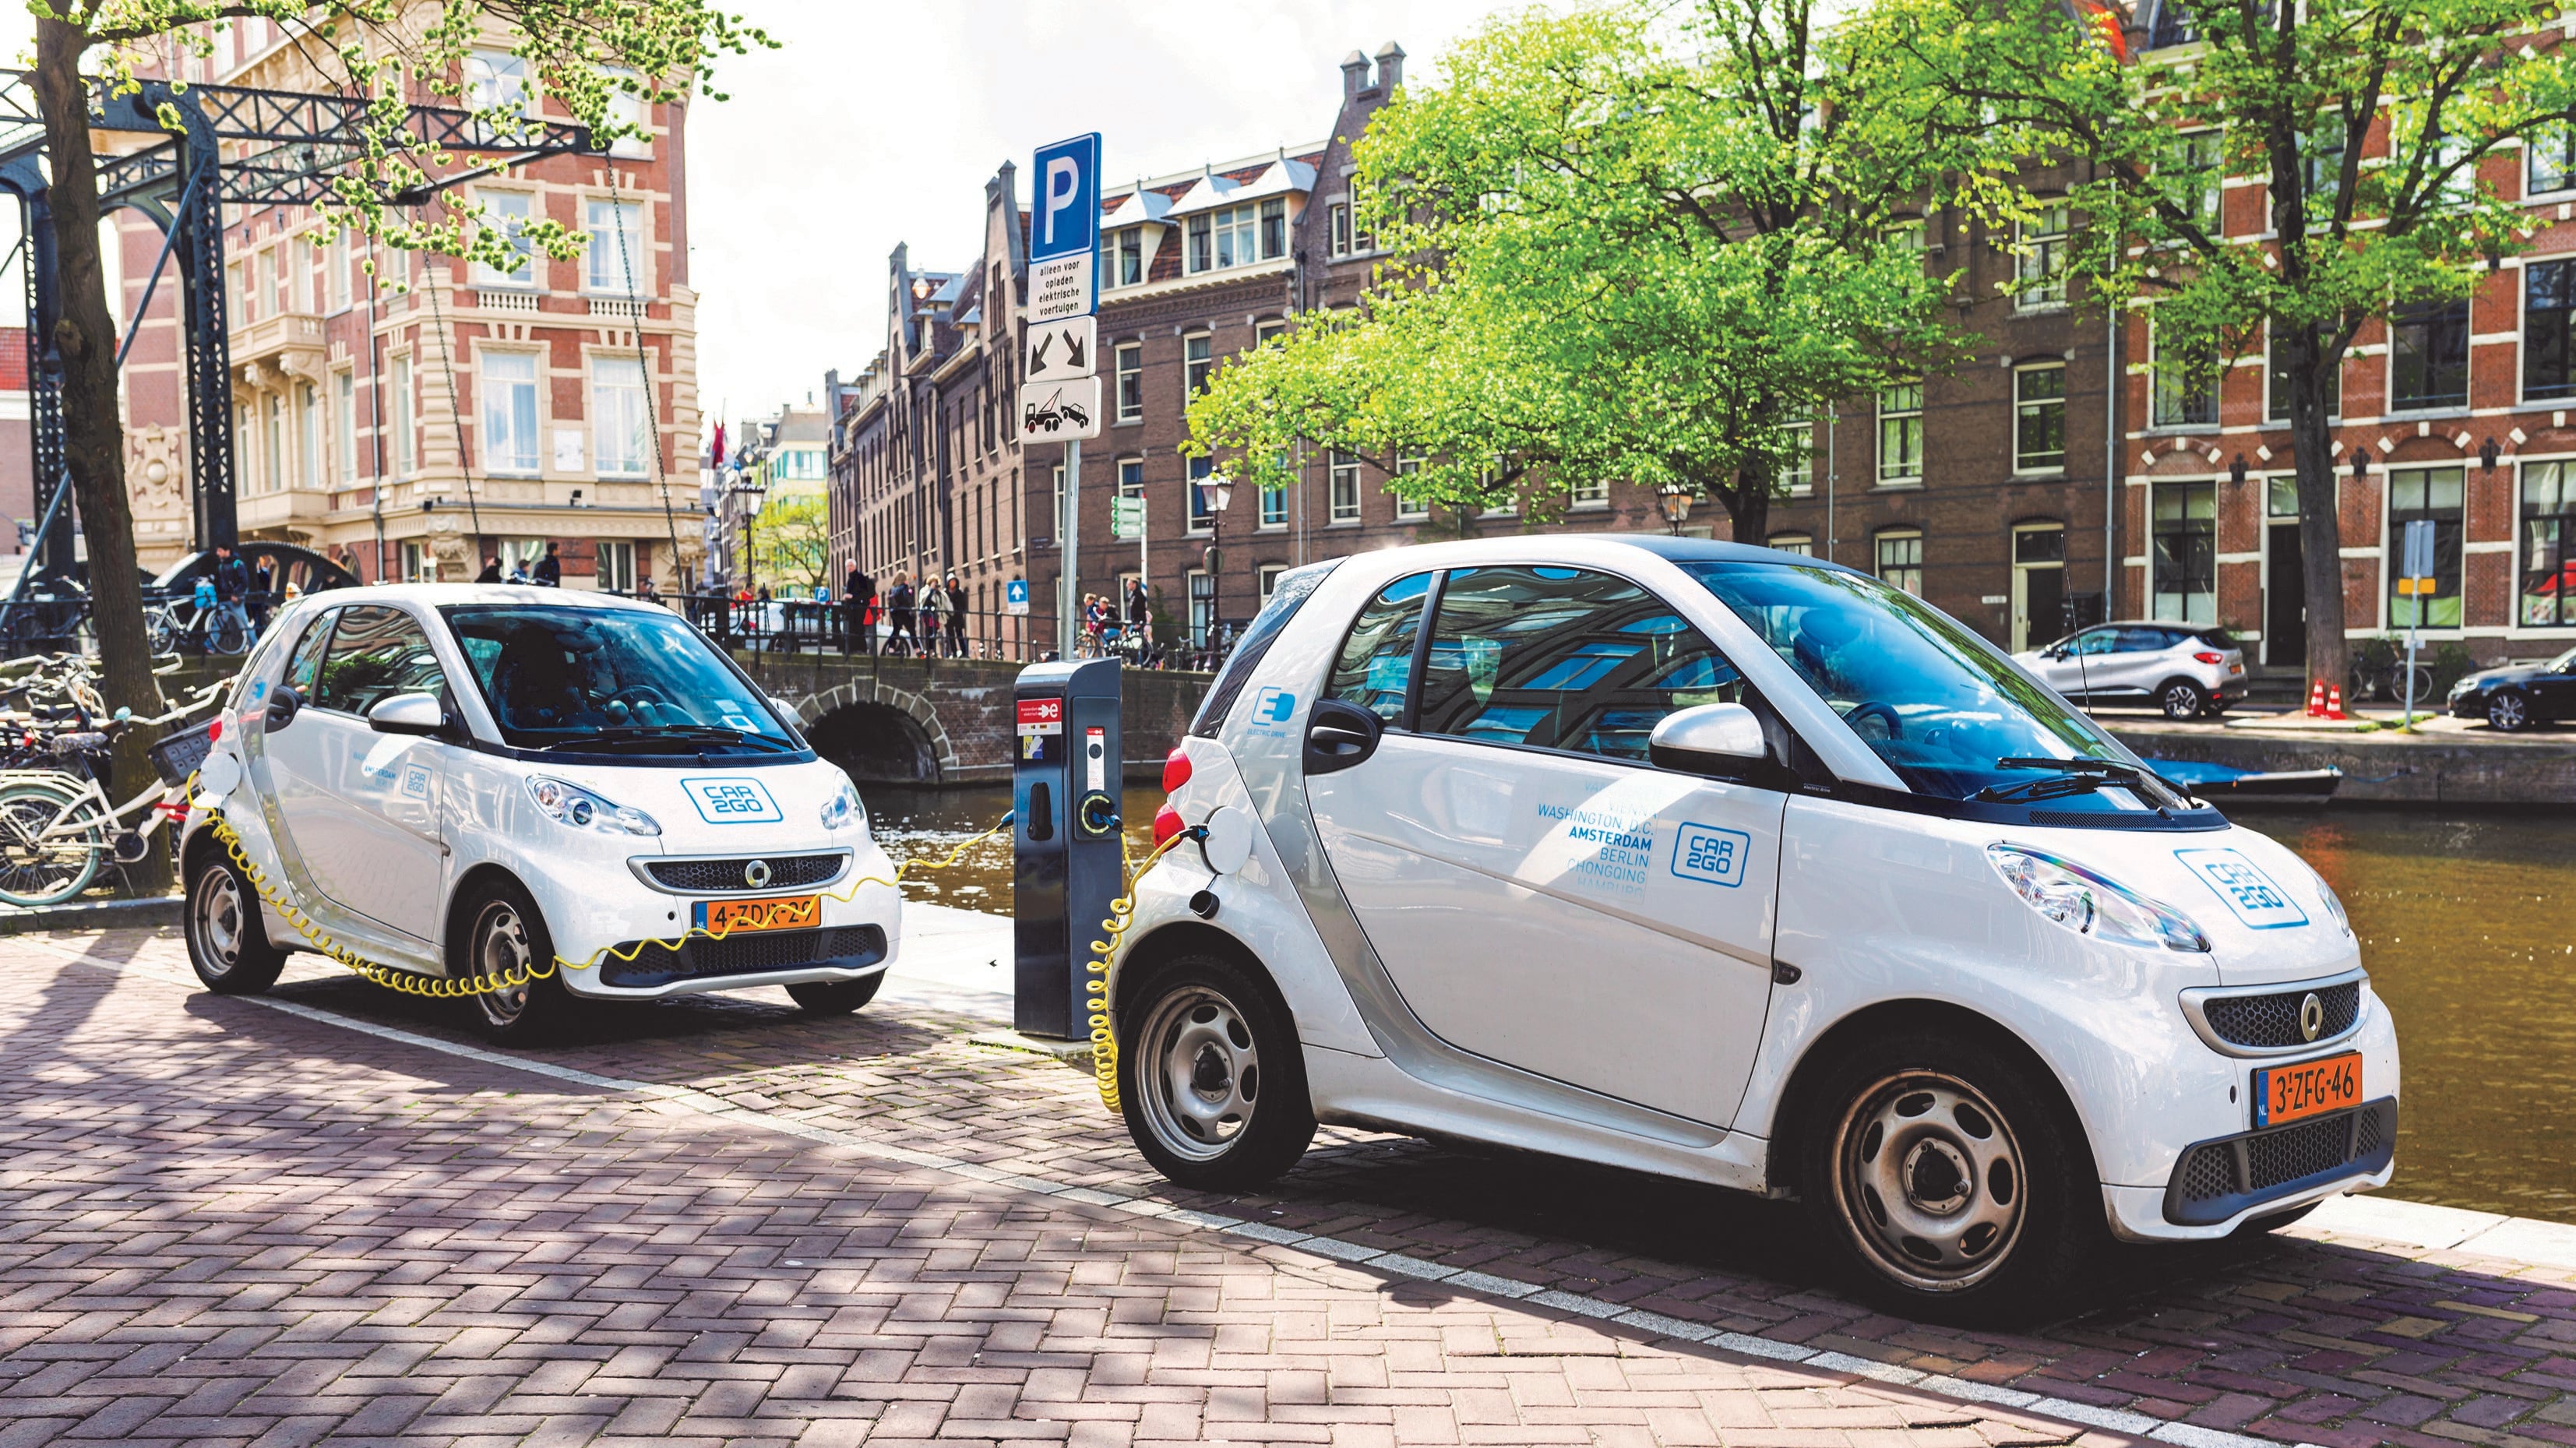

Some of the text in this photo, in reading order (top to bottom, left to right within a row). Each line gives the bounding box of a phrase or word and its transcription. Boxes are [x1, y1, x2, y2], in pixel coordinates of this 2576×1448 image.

[1045, 156, 1079, 245] P
[1040, 261, 1080, 276] alleen voor
[1045, 276, 1073, 289] opladen
[1039, 287, 1080, 303] elektrische
[1040, 302, 1079, 315] voertuigen
[1247, 728, 1270, 737] ELECTRIC
[407, 780, 425, 793] 2GO
[409, 771, 426, 784] CAR
[703, 786, 756, 798] CAR
[711, 799, 763, 813] 2GO
[1538, 803, 1654, 836] WASHINGTON, D.C.
[1568, 826, 1652, 851] AMSTERDAM
[1690, 835, 1734, 858] CAR
[1600, 847, 1649, 868] BERLIN
[1686, 852, 1731, 874] 2GO
[1567, 858, 1646, 884] CHONGQING
[2205, 863, 2262, 885] CAR
[2230, 886, 2285, 910] 2GO
[2258, 1062, 2354, 1117] NL 3-ZFG-46
